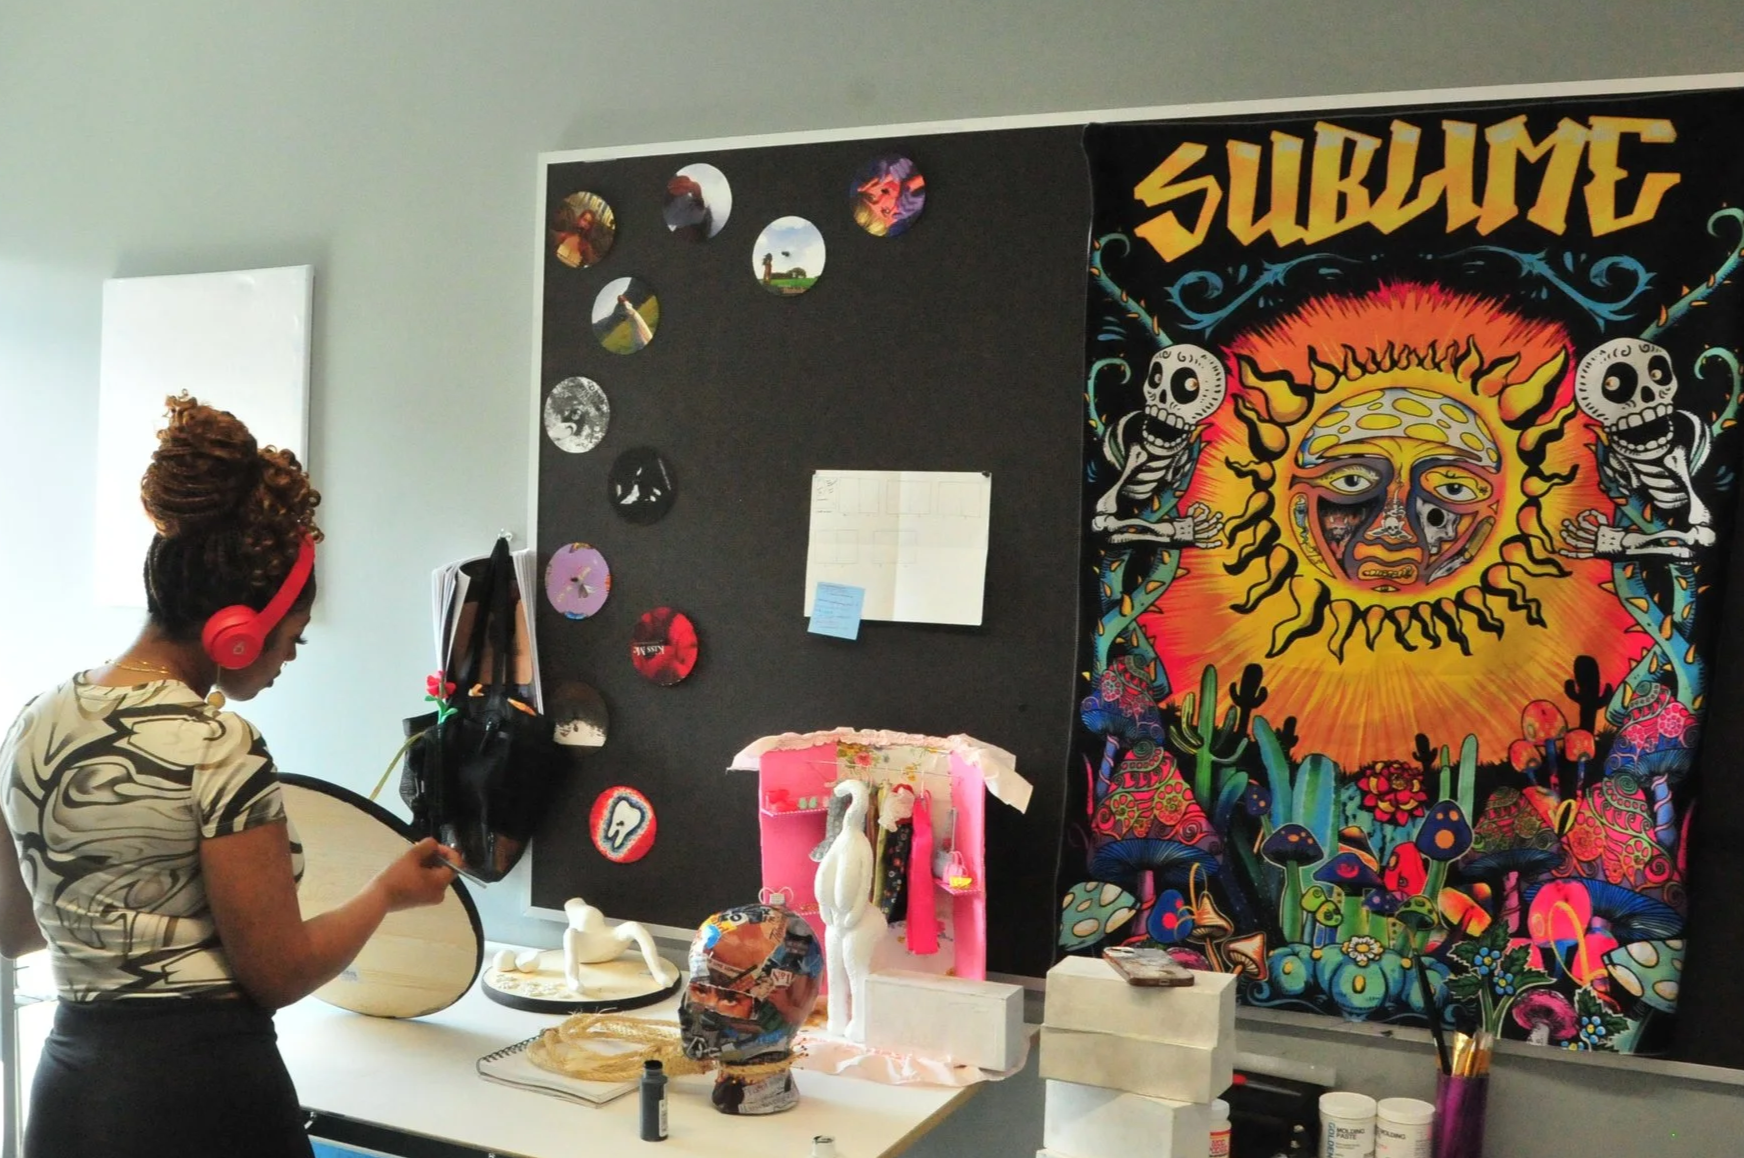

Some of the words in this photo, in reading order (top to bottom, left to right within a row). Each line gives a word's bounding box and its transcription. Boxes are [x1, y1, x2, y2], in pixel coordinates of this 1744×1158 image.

[1134, 114, 1681, 263] SUBLIME
[646, 645, 665, 655] Kiss
[1336, 1127, 1365, 1135] MOLDING
